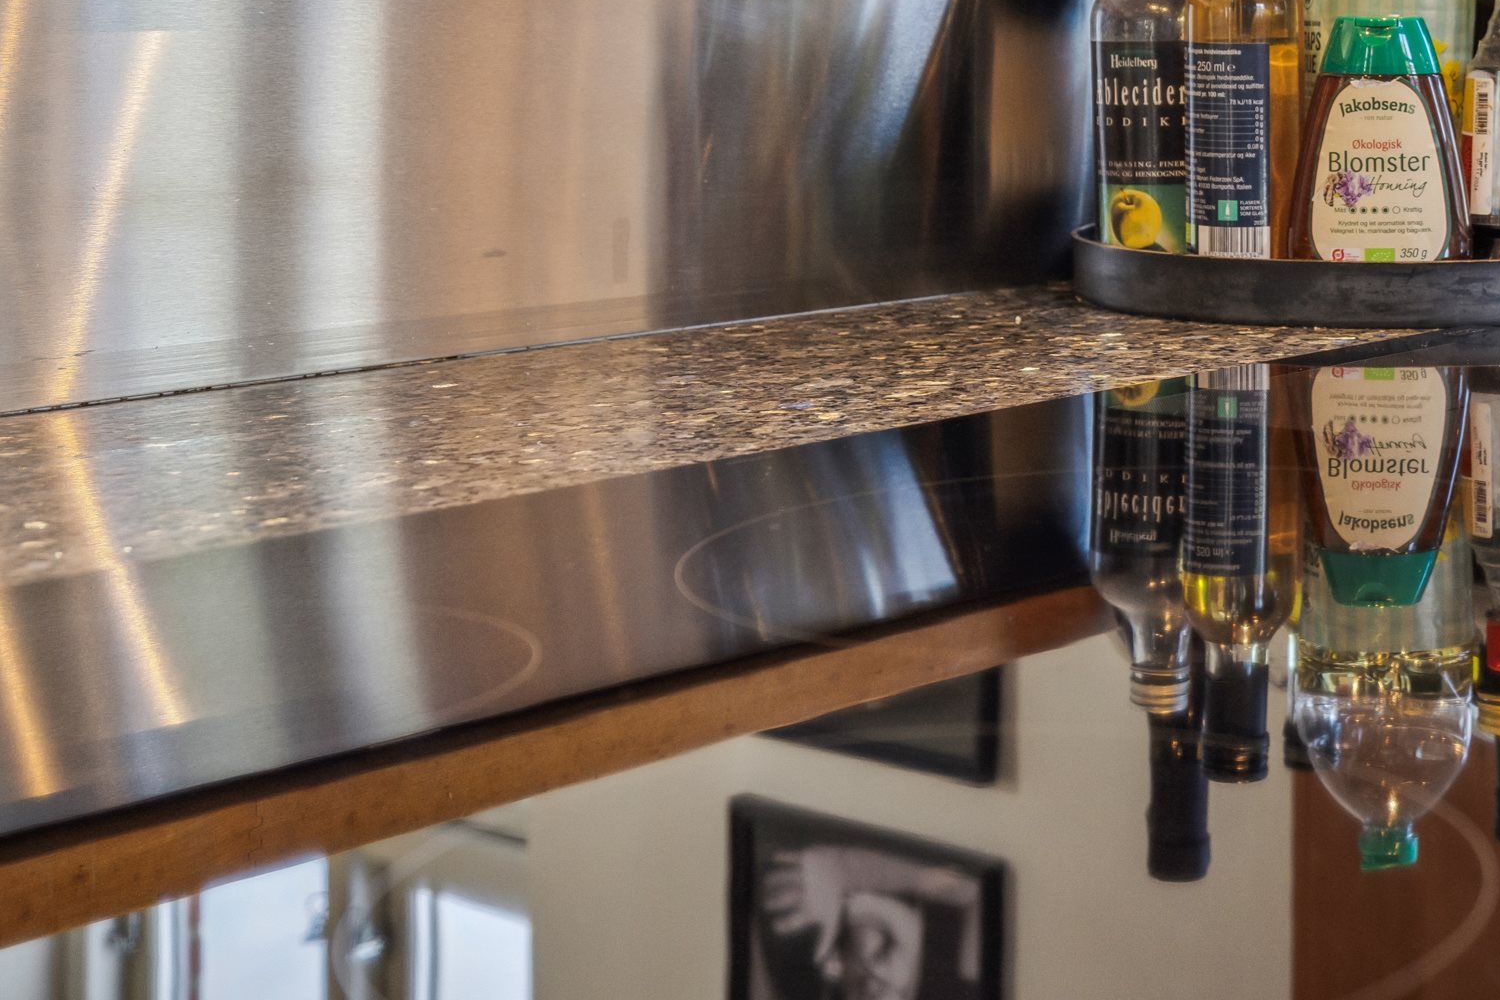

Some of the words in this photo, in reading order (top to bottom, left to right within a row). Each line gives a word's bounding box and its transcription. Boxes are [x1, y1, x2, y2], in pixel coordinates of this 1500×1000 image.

[1110, 54, 1158, 70] Heidelberg
[1197, 61, 1211, 72] 250
[1213, 62, 1225, 72] ml
[1339, 97, 1416, 117] Jakobsens
[1352, 139, 1402, 151] Økologisk
[1329, 151, 1430, 173] Blomster
[1367, 175, 1428, 198] Honning
[1400, 248, 1419, 258] 350
[1421, 249, 1428, 260] g
